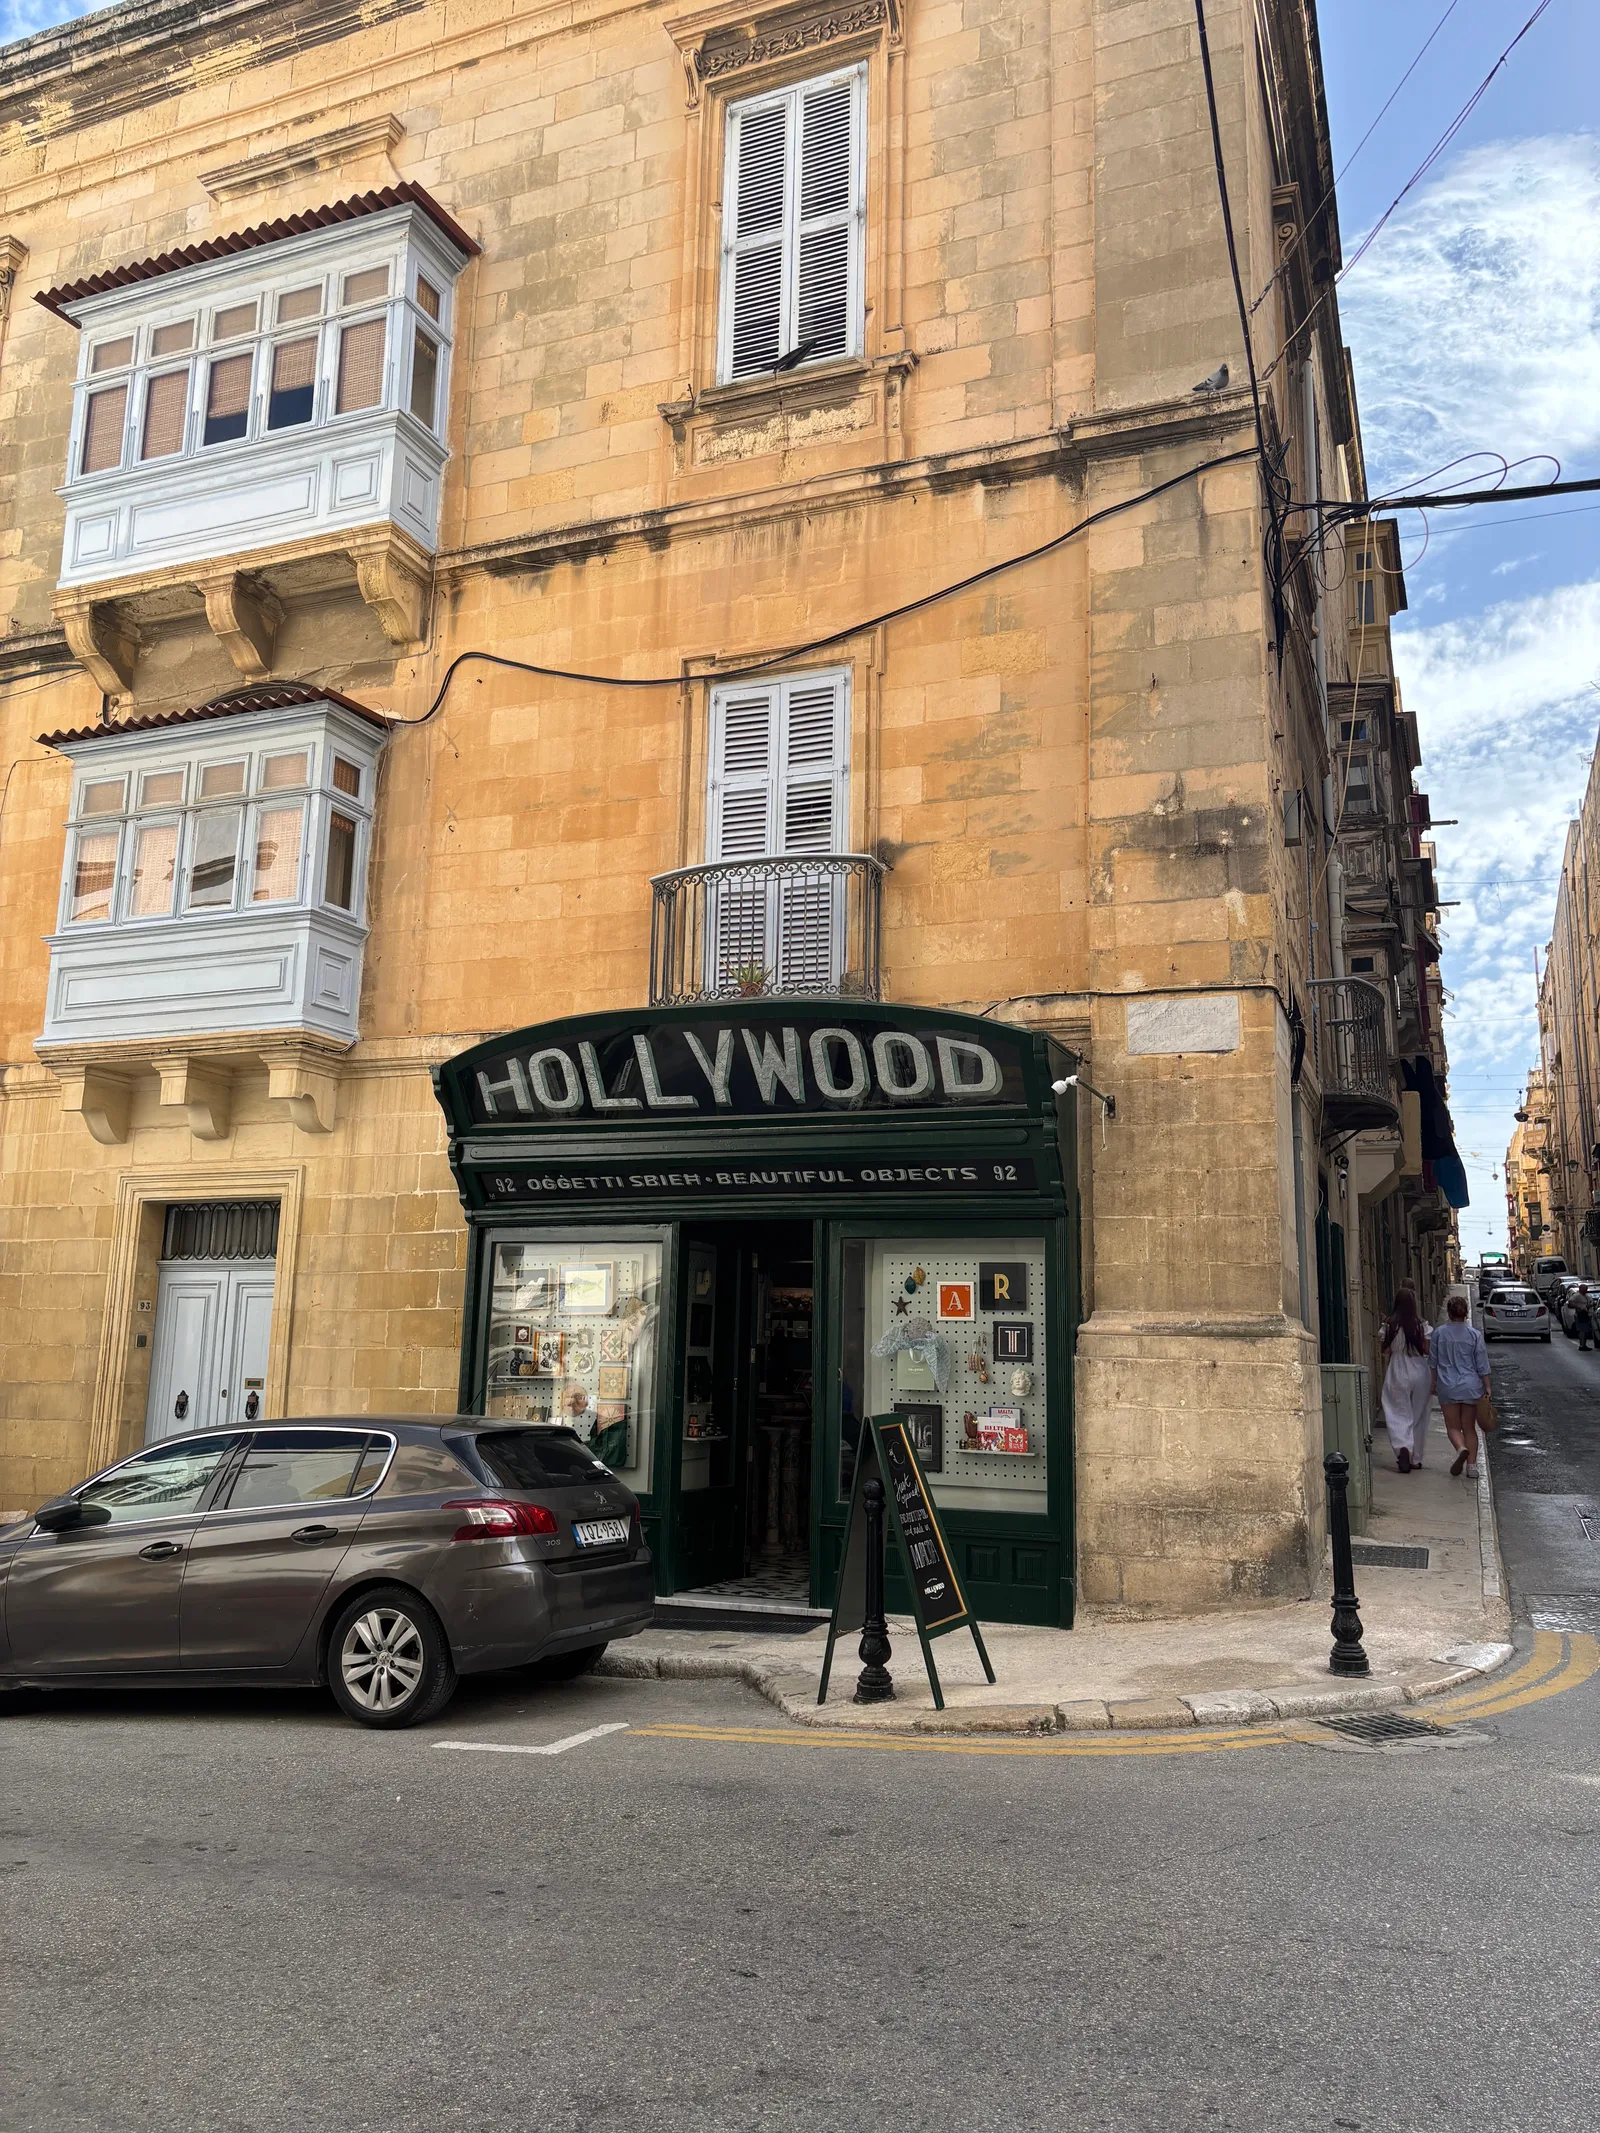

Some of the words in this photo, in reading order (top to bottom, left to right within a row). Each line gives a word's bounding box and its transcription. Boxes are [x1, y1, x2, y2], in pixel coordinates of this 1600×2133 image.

[477, 1027, 1003, 1115] HOLLYWOOD
[496, 1178, 517, 1193] 92
[527, 1174, 625, 1191] OĠĠETTI
[716, 1169, 854, 1186] BEAUTIFUL
[860, 1167, 979, 1183] OBJECTS
[993, 1165, 1018, 1181] 92
[994, 1273, 1010, 1300] R
[140, 1301, 151, 1310] 93
[947, 1291, 964, 1311] A
